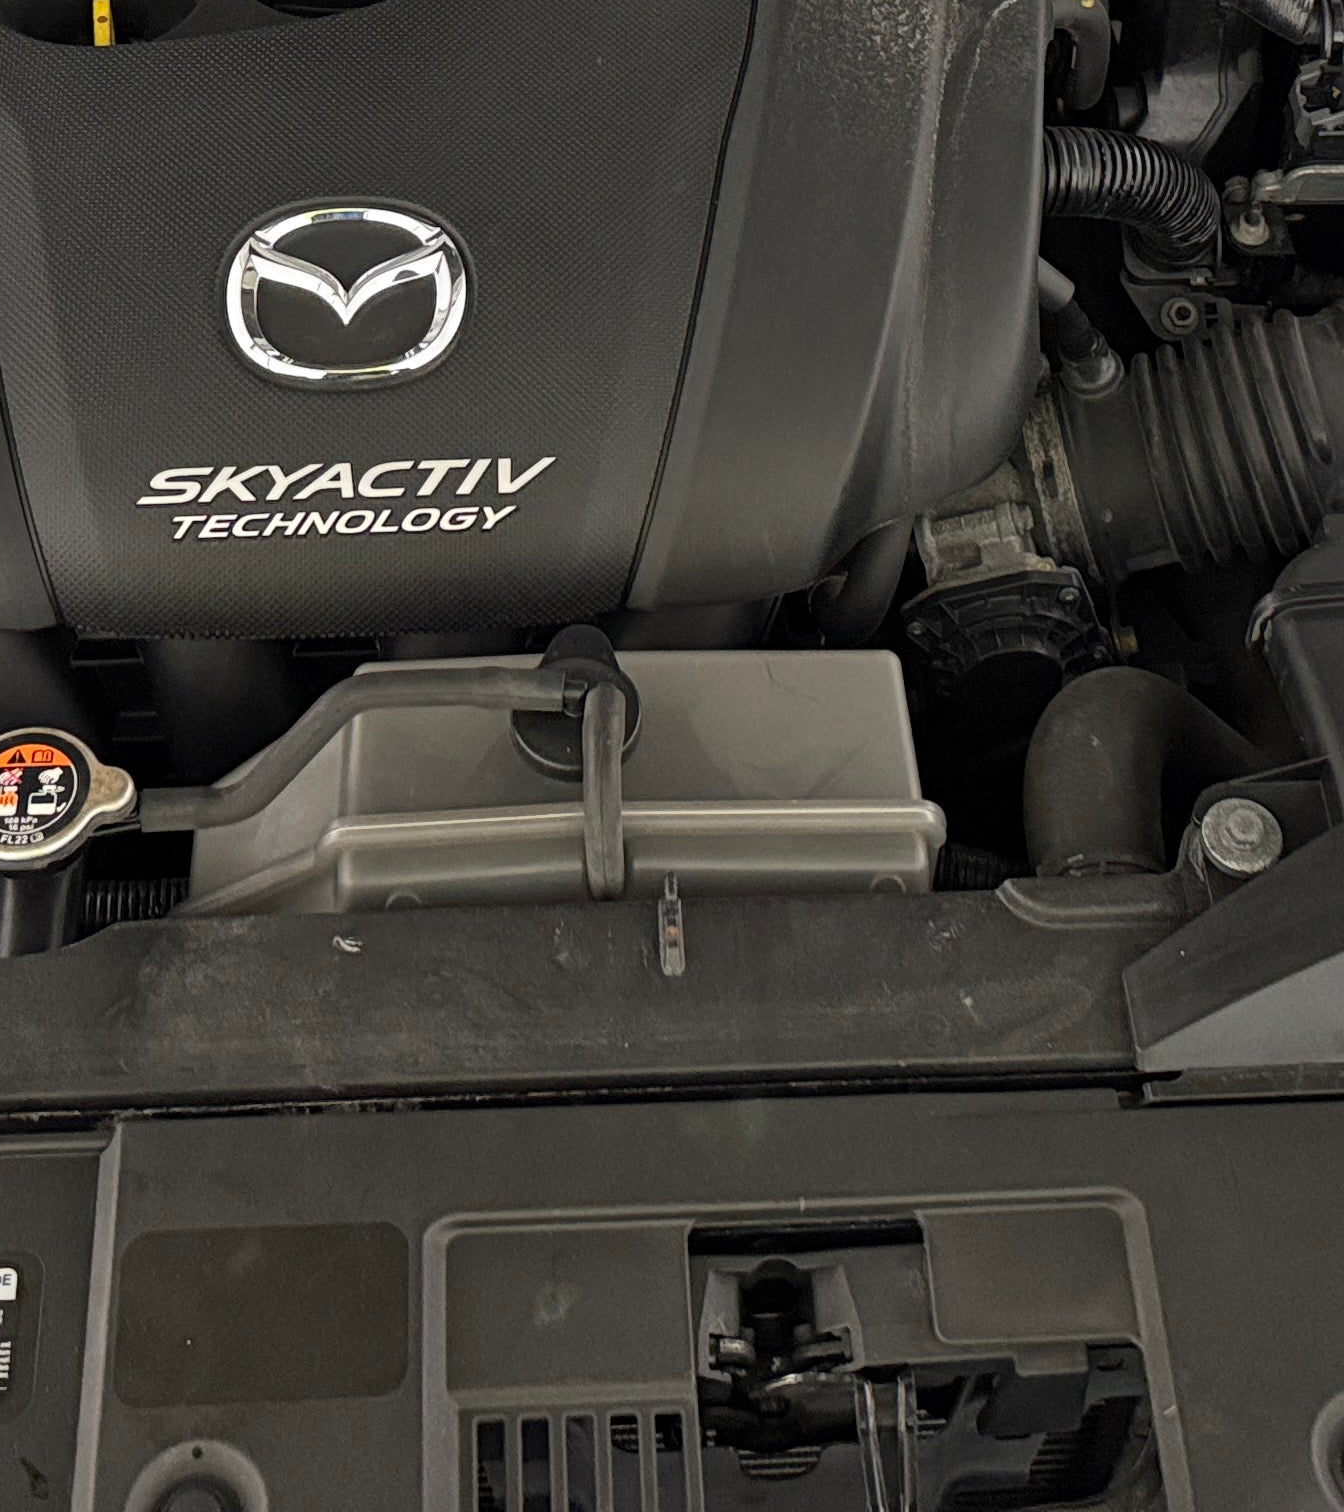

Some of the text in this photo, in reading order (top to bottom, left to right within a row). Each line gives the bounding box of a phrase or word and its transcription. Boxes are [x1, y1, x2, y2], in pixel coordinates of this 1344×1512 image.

[135, 456, 557, 506] SKYACTIV
[172, 505, 516, 540] TECHNOLOGY
[0, 834, 28, 845] FL22
